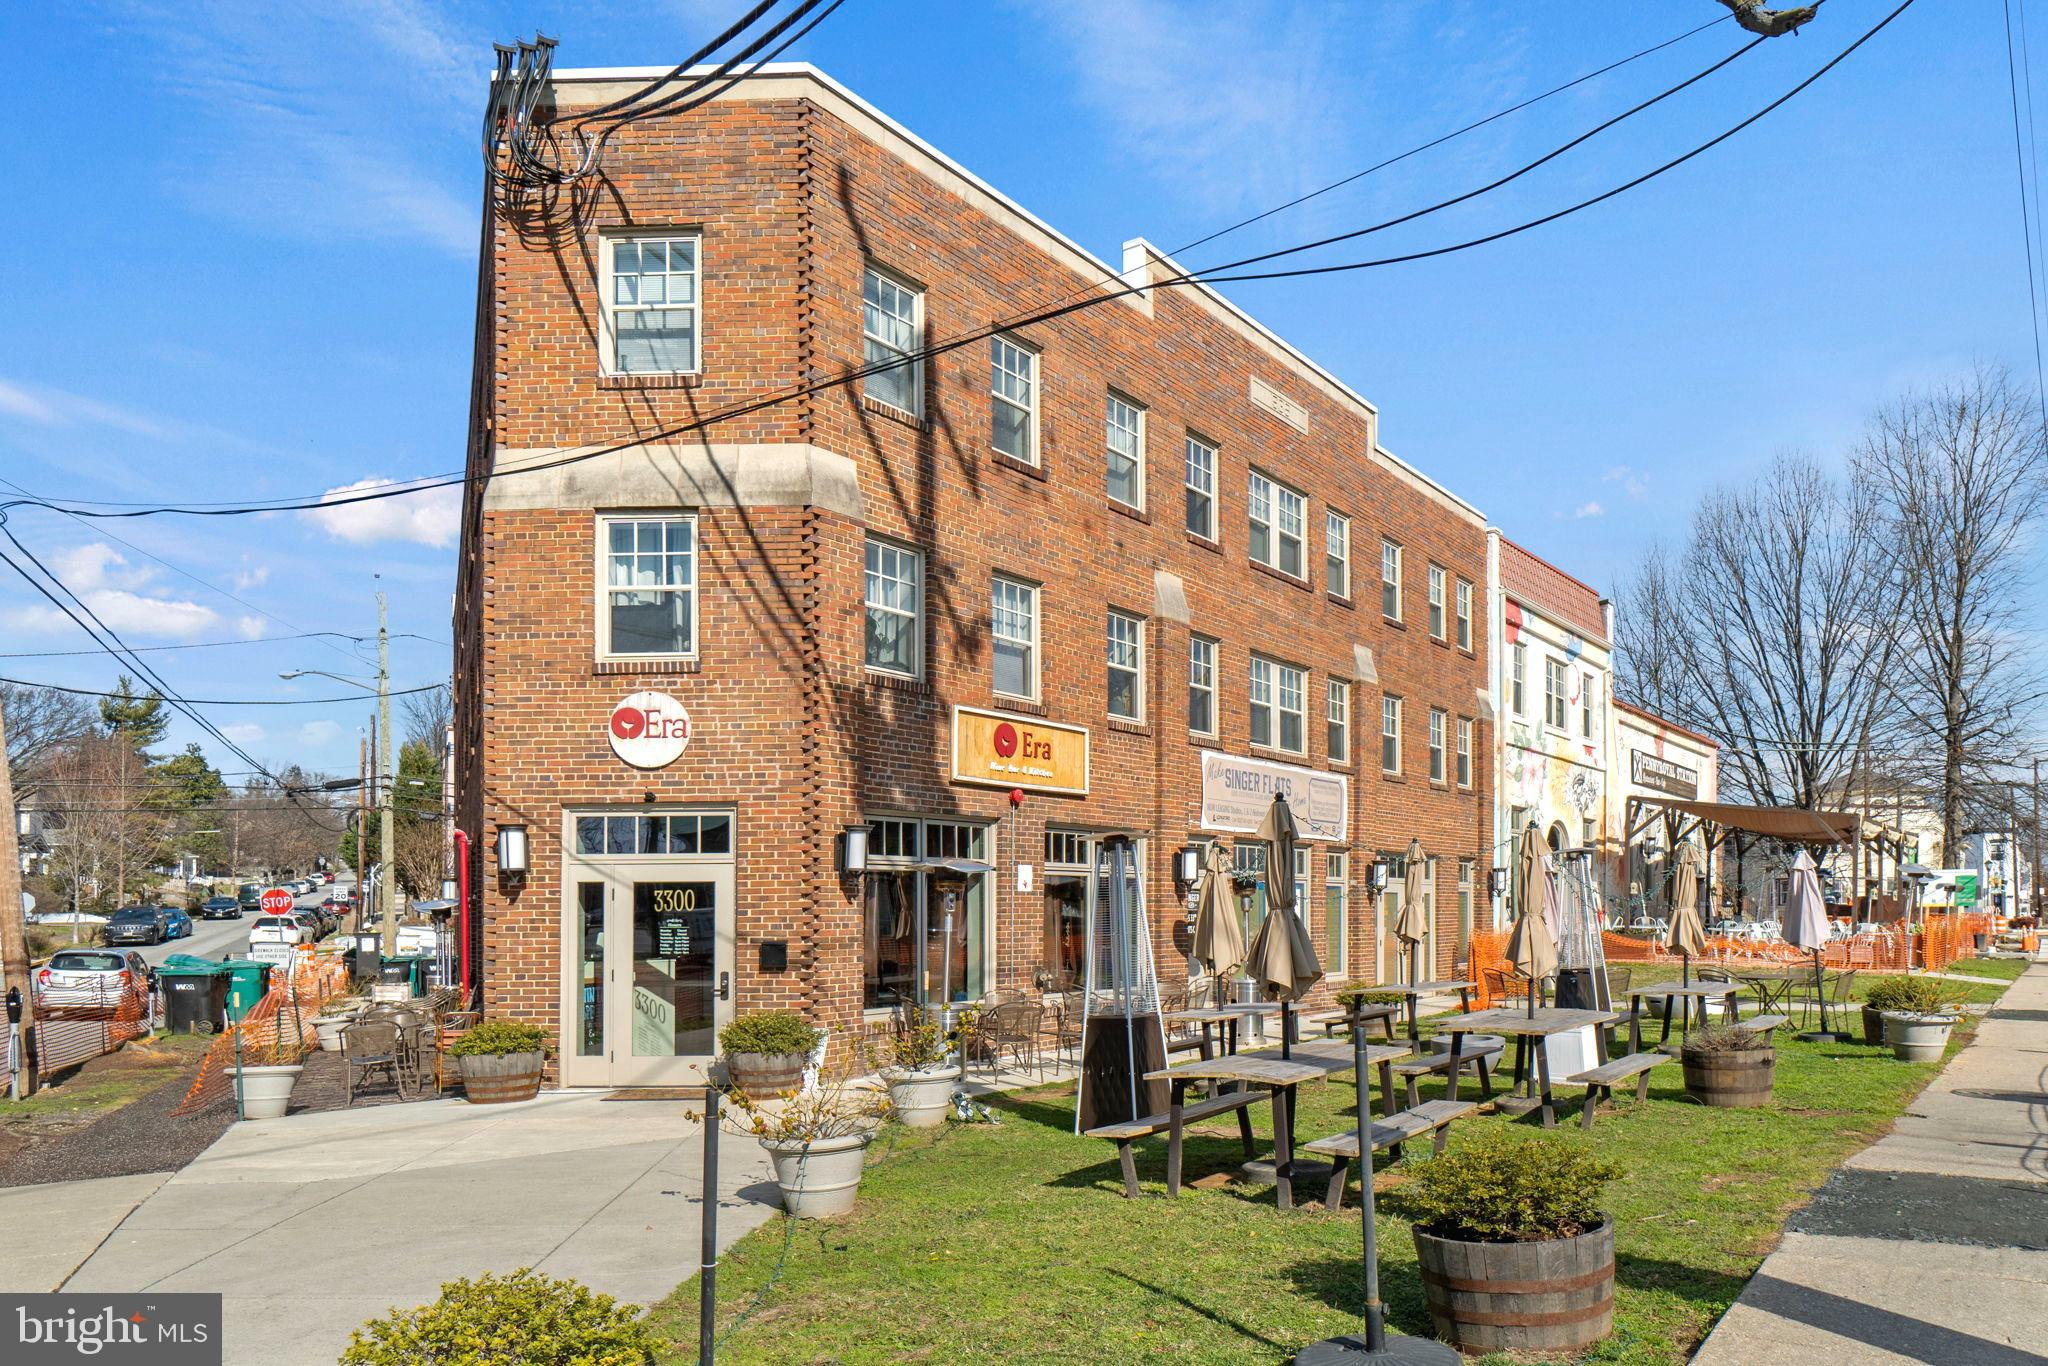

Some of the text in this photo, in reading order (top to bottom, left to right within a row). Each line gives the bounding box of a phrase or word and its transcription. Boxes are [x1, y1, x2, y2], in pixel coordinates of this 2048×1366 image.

[644, 709, 688, 739] Era
[1022, 731, 1051, 760] Era
[1225, 768, 1260, 792] SINGER
[1262, 774, 1292, 797] FLATS
[263, 896, 291, 908] STOP
[654, 889, 695, 912] 3300
[634, 989, 666, 1024] 3300
